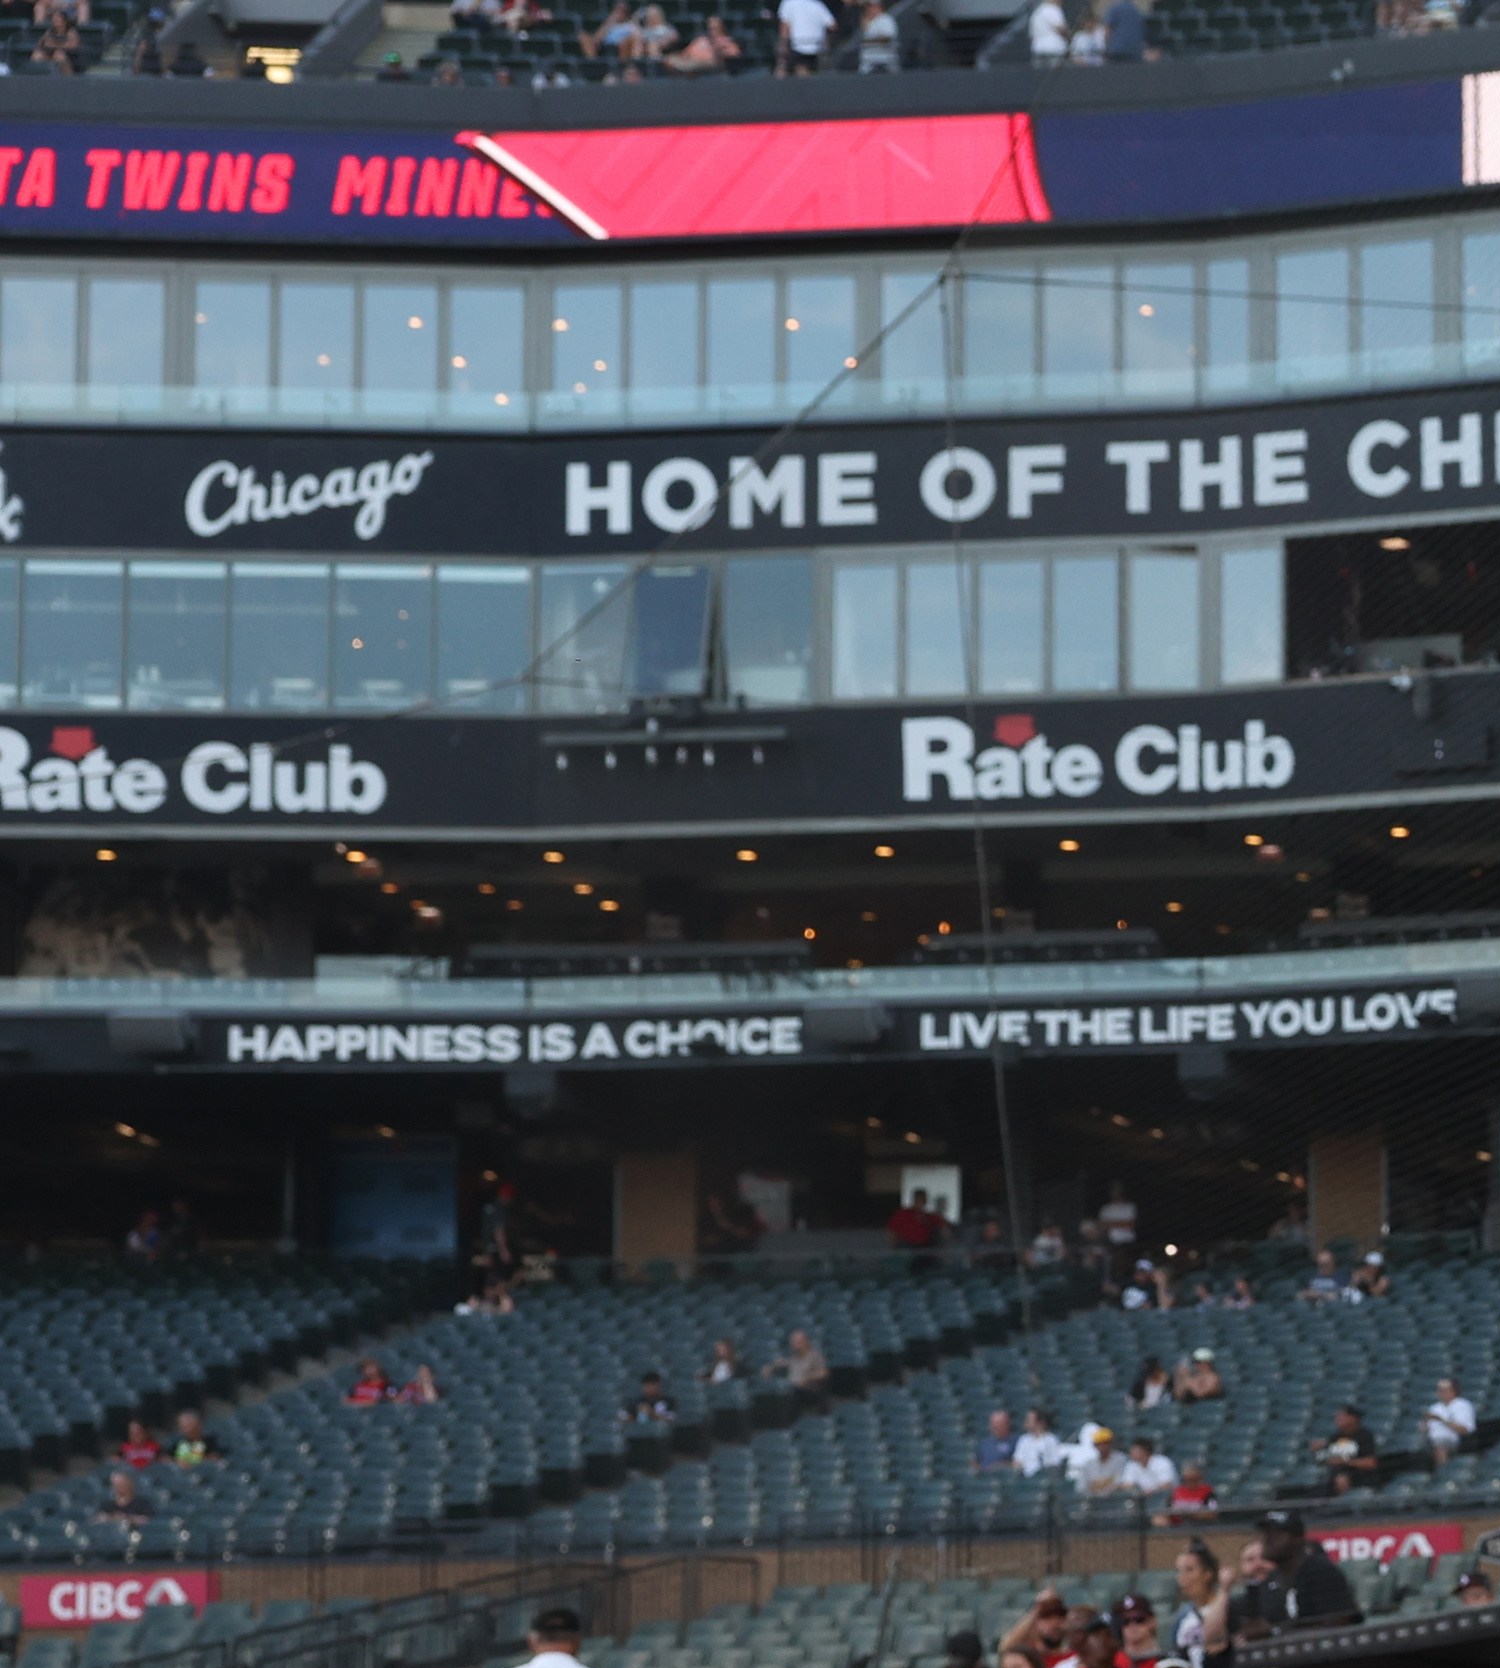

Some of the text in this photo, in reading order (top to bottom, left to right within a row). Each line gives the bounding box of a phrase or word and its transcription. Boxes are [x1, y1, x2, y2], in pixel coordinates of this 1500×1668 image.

[86, 149, 294, 213] TWINS
[332, 155, 553, 217] MINNE
[185, 450, 434, 539] Chicago
[566, 453, 877, 535] HOME
[921, 444, 1066, 522] OF
[1107, 430, 1307, 513] THE
[0, 727, 387, 814] Rate Club
[902, 716, 1295, 800] Rate Club
[227, 1024, 520, 1062] HAPPINESS
[527, 1023, 573, 1063] IS
[580, 1021, 620, 1060] A
[920, 1011, 1030, 1050] LIVE
[1034, 1008, 1133, 1046] THE
[1139, 1005, 1235, 1043] LIFE
[1241, 997, 1334, 1039] YOU
[49, 1580, 144, 1620] CIBC
